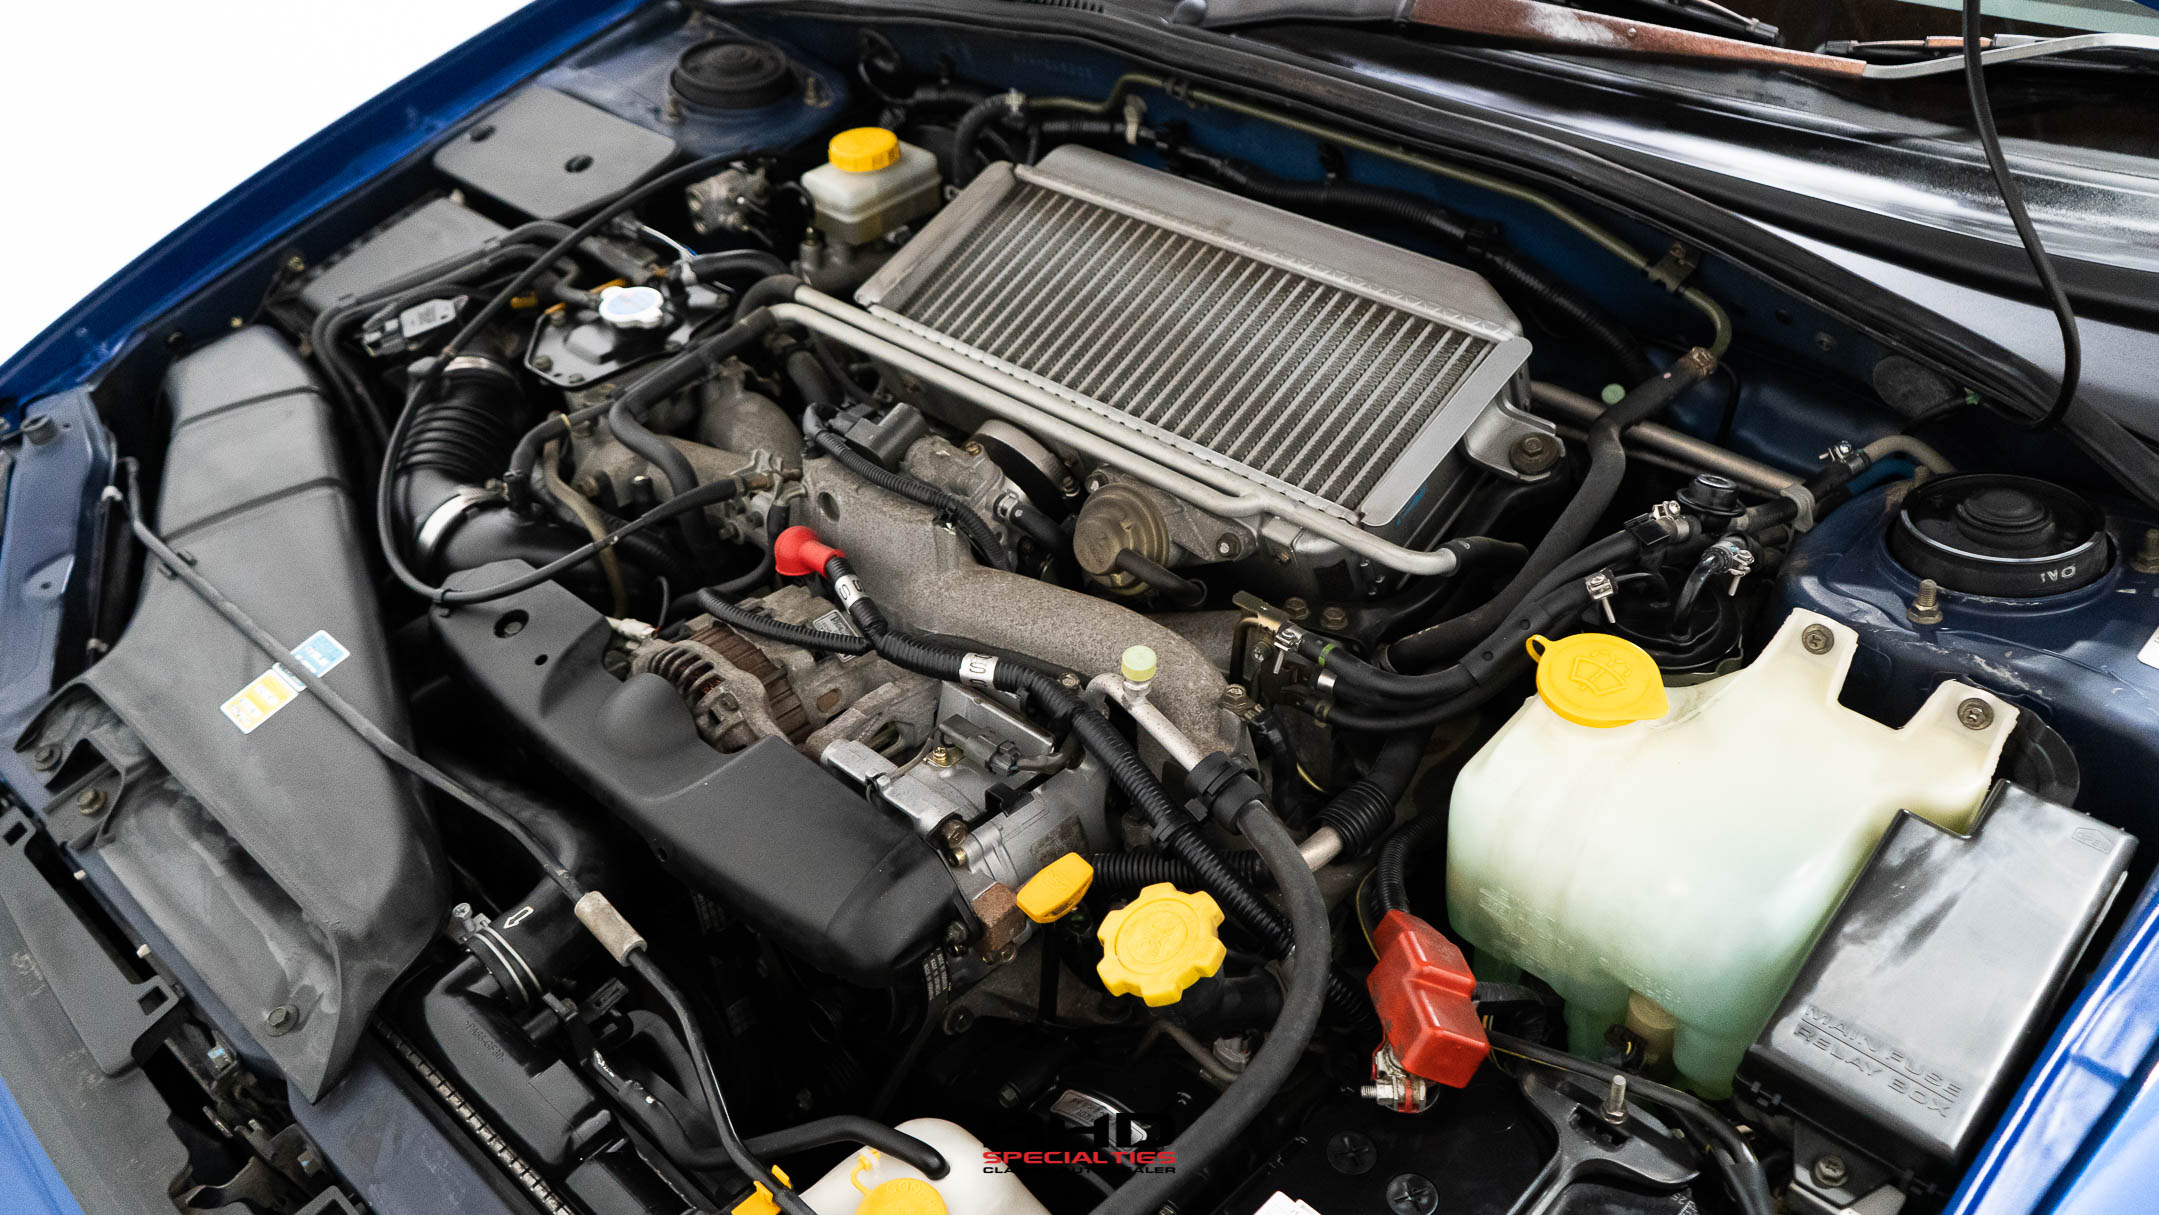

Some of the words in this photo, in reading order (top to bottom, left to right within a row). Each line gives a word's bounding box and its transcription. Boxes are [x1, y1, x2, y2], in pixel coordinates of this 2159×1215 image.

[1803, 1003, 1887, 1053] MAIN
[1793, 1023, 1884, 1077] RELAY
[1887, 1077, 1951, 1118] BOX
